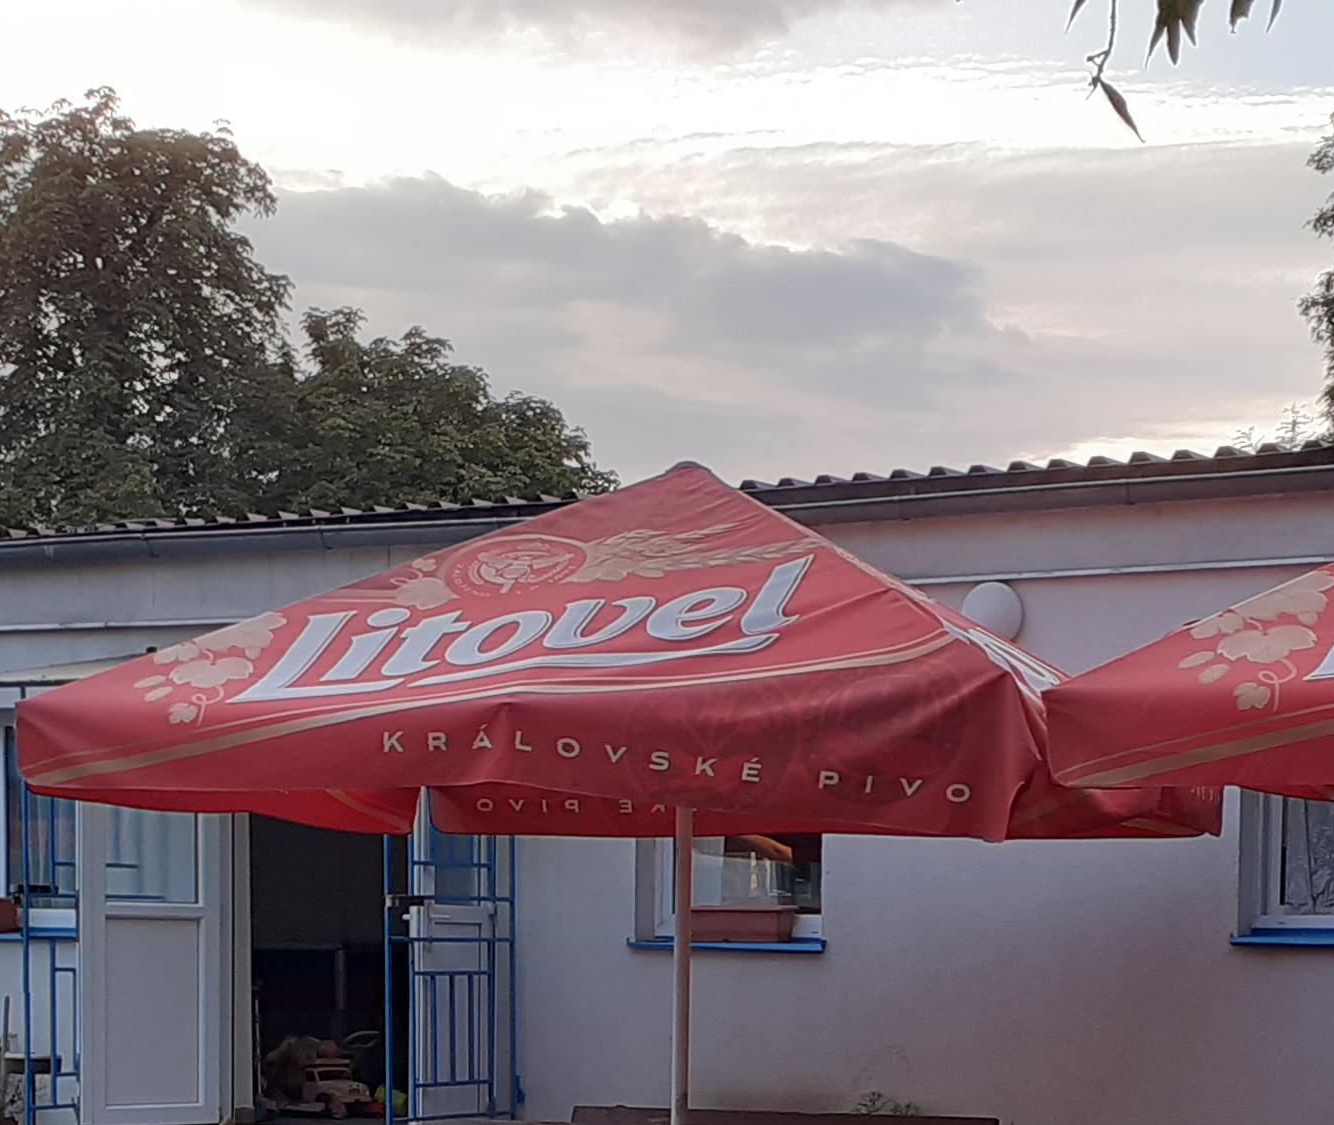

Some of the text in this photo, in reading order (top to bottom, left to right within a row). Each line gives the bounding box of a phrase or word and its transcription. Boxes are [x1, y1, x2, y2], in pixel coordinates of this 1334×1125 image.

[226, 553, 815, 703] Litovel
[381, 723, 973, 803] KRÁLOVSKÉ PIVO
